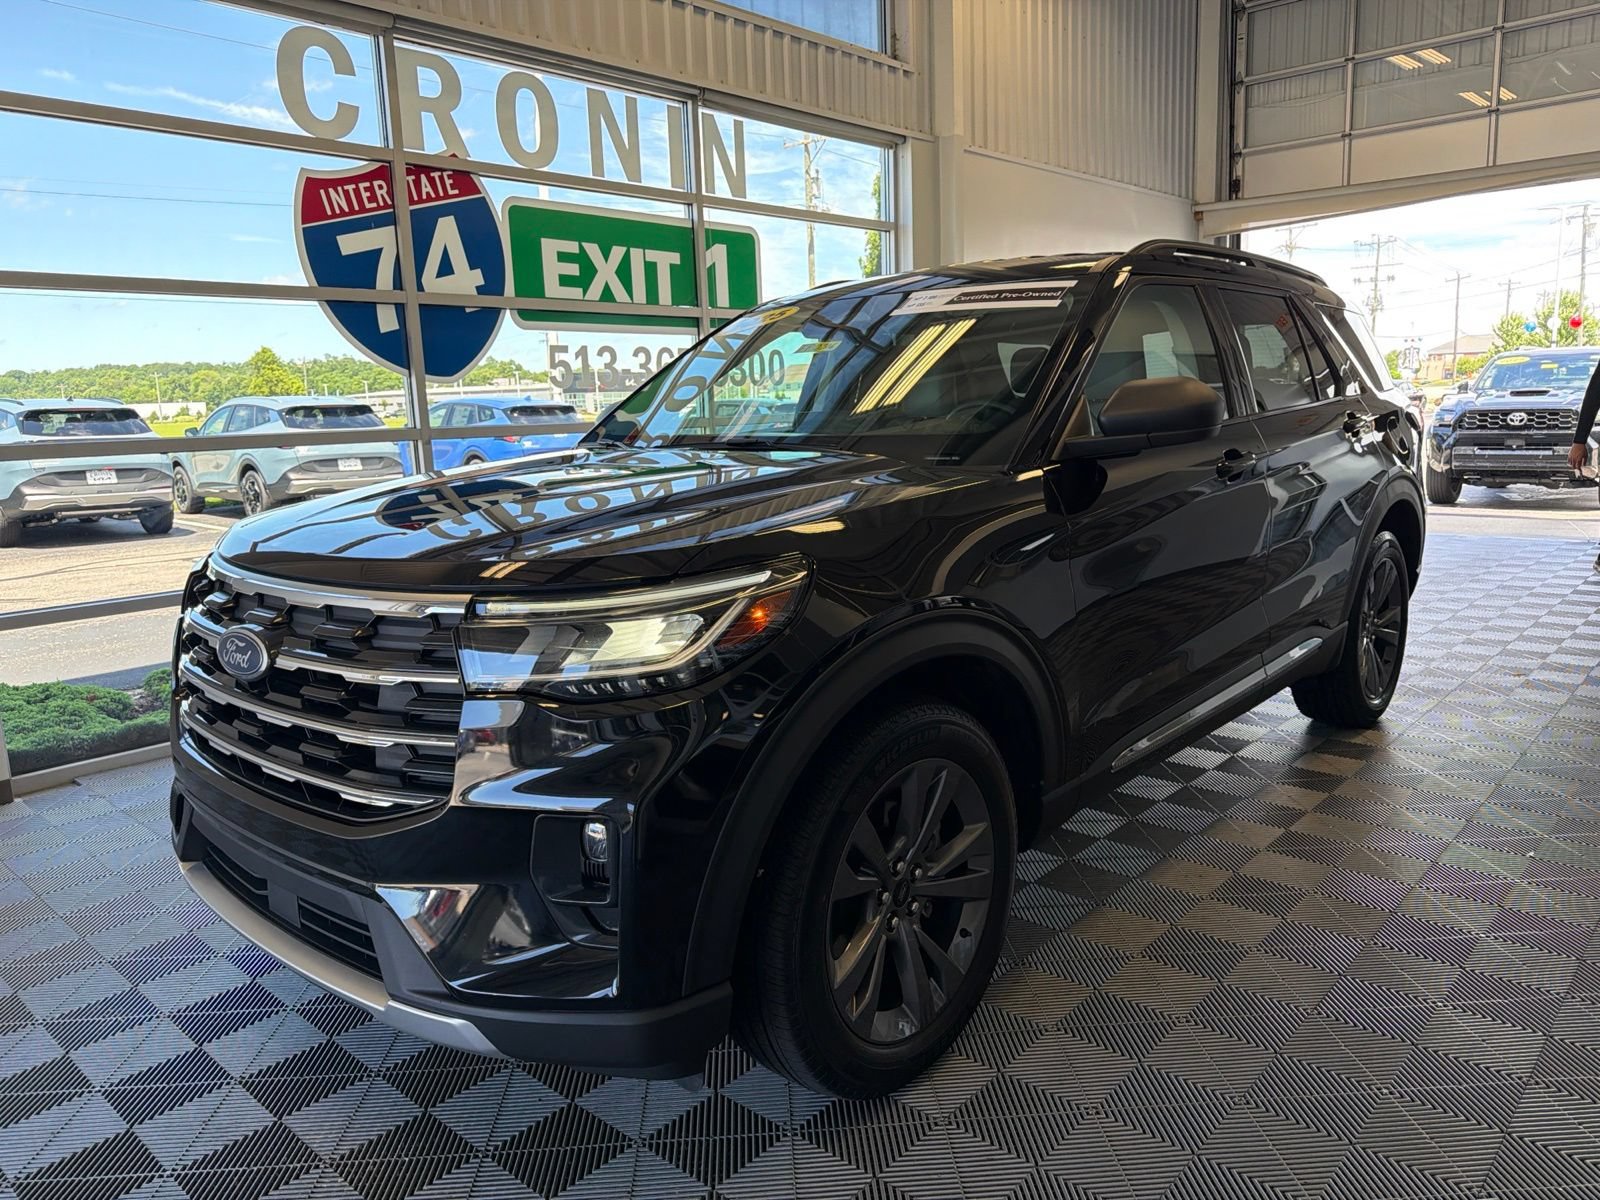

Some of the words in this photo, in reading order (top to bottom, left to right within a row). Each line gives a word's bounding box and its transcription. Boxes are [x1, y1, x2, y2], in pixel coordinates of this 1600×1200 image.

[276, 25, 748, 200] CRONIN
[320, 171, 460, 216] INTERTATE
[336, 215, 486, 335] 74
[540, 237, 681, 307] EXIT
[704, 243, 730, 308] 1
[953, 292, 999, 302] Certified
[1000, 289, 1062, 299] Pre-Owned
[223, 637, 252, 669] Ford
